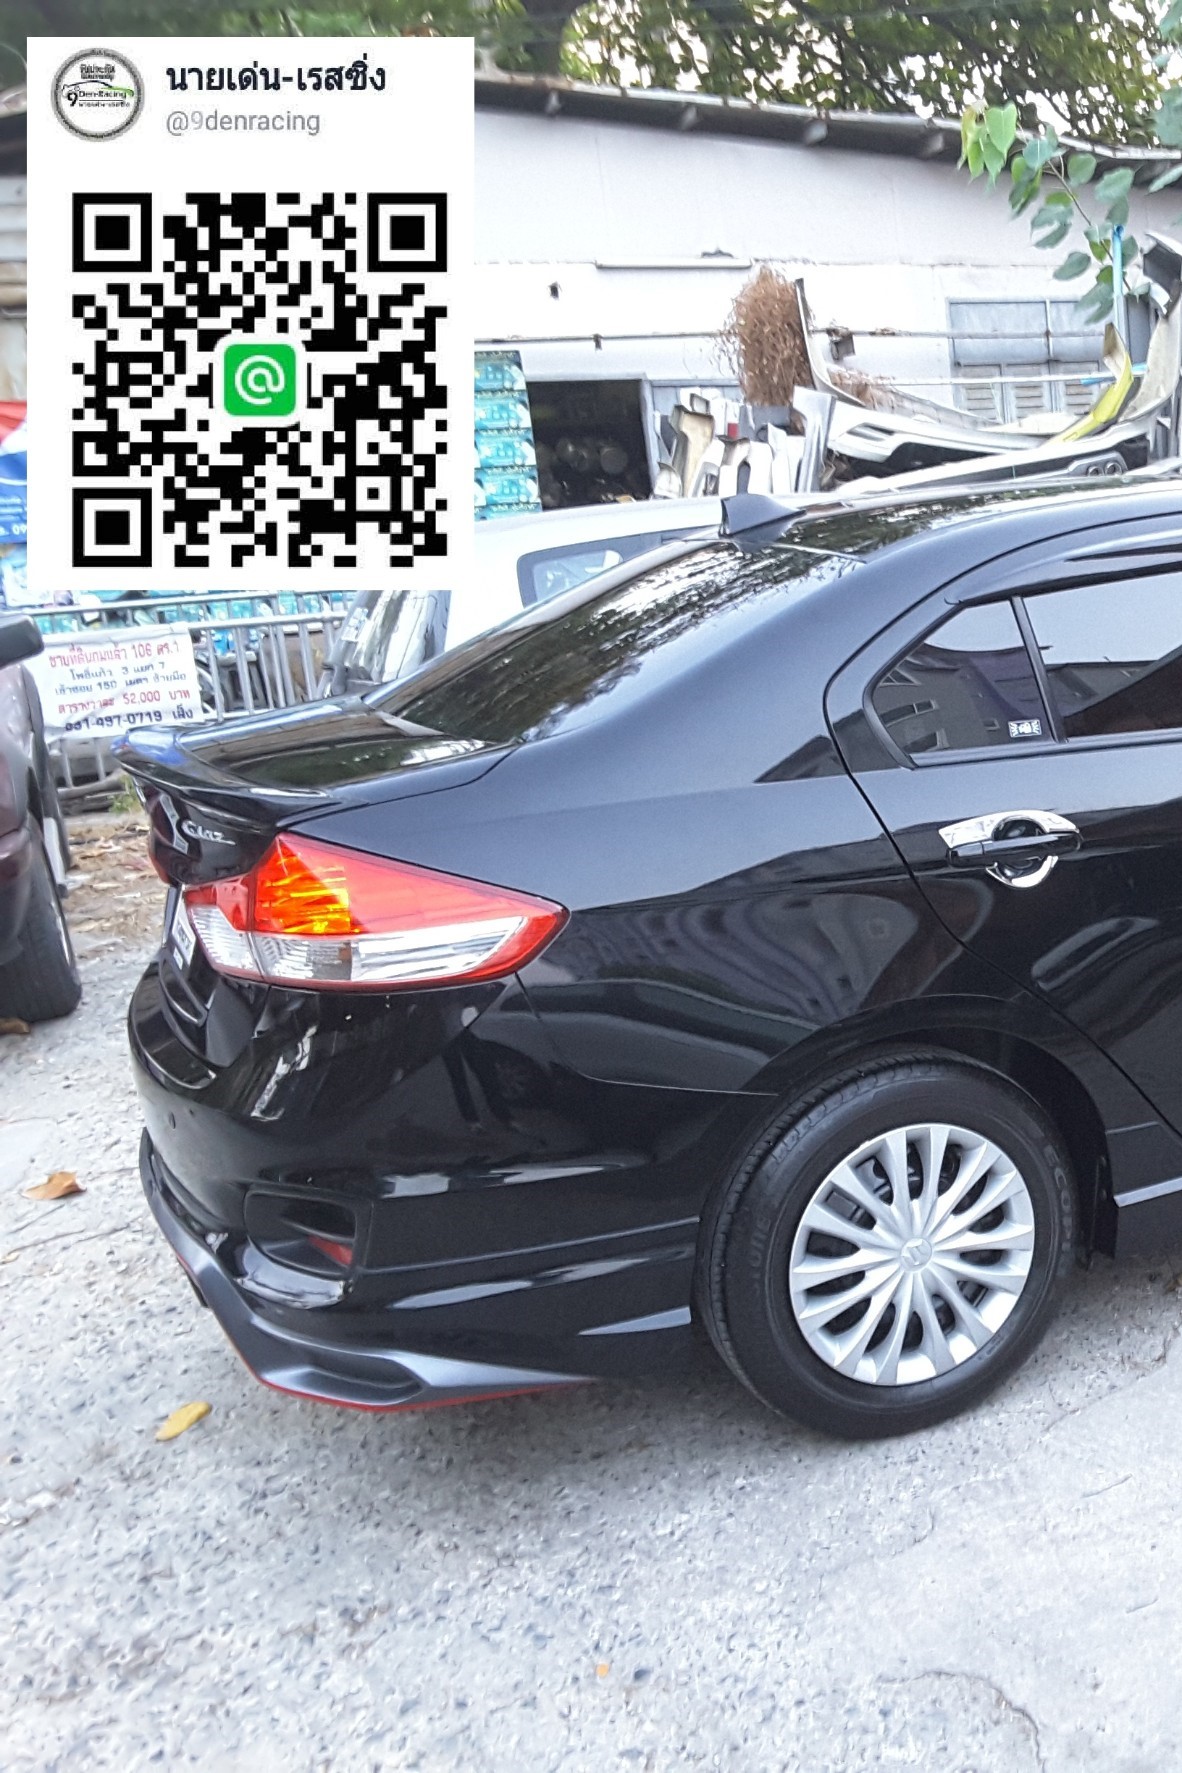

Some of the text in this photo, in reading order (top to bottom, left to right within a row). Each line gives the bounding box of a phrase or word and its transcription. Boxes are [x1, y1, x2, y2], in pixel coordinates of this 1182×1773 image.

[131, 643, 152, 658] 106
[122, 690, 161, 705] 52,000
[168, 689, 191, 700] บาท
